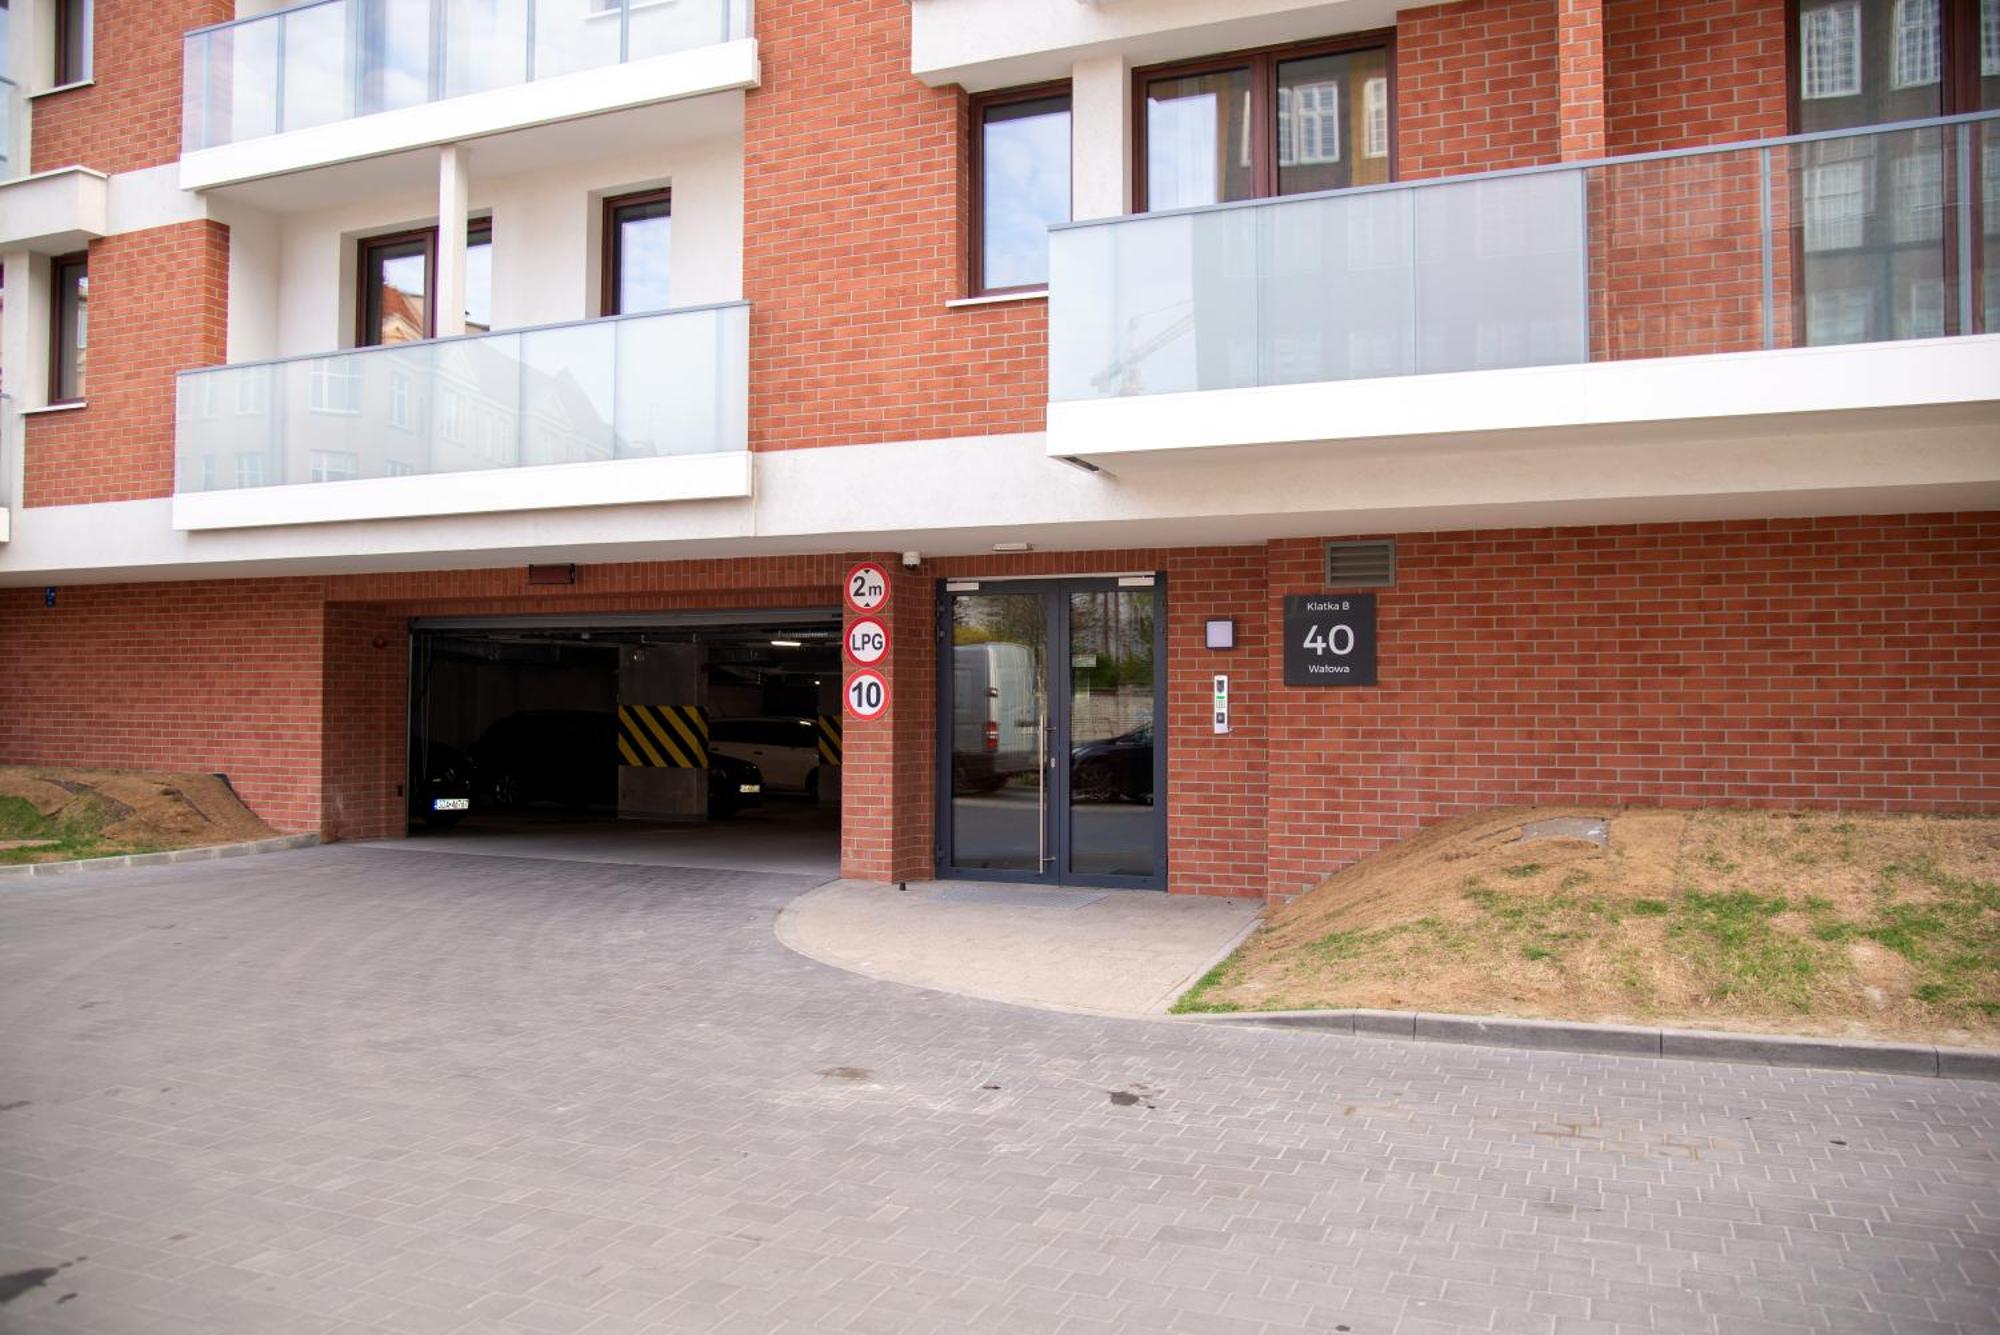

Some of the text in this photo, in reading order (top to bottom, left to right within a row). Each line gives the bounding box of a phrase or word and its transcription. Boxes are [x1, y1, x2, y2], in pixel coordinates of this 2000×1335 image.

[1307, 601, 1350, 611] Klatka B
[852, 633, 883, 651] LPG
[1303, 624, 1355, 655] 40
[1308, 664, 1350, 673] Wałowa
[852, 681, 881, 708] 10
